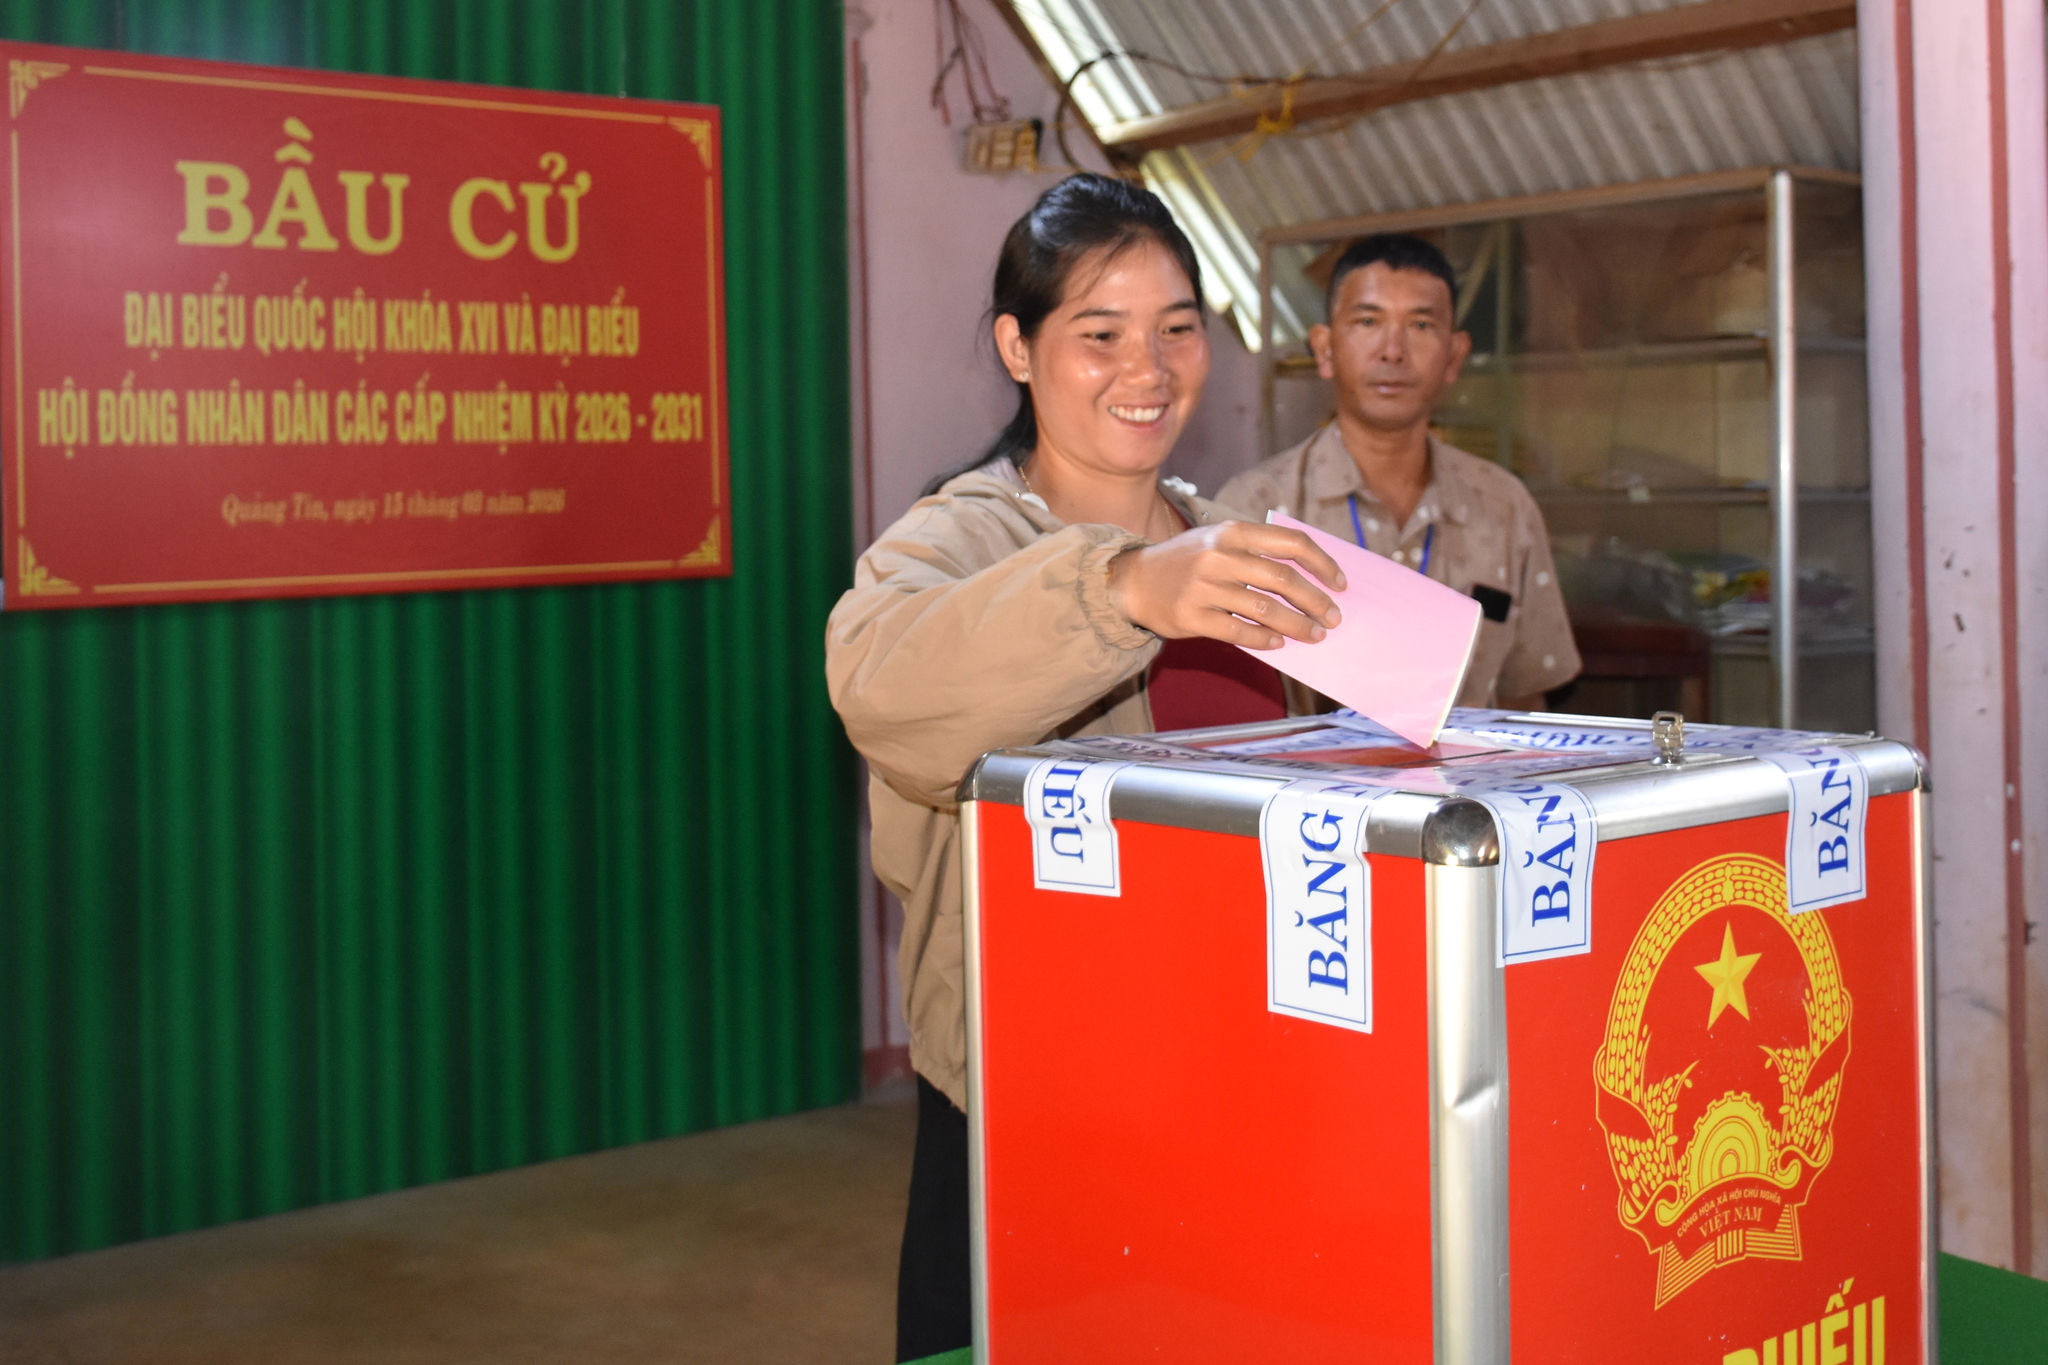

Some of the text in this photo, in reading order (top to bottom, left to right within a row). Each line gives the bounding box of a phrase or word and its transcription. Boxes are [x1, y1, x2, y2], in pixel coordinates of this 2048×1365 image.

[175, 117, 591, 262] BẦU CỬ
[125, 272, 640, 367] ĐẠI BIỂU QUỐC HỘI KHÓA XVI VÀ ĐẠI BIỂU
[39, 376, 89, 460] HỘI
[99, 370, 178, 446] ĐỒNG
[187, 378, 265, 445] NHÂN
[273, 378, 328, 445] DÂN
[336, 378, 388, 444] CÁC
[395, 371, 447, 444] CẤP
[453, 380, 532, 455] NHIỆM
[538, 381, 568, 442] KỲ
[575, 392, 631, 443] 2026
[652, 392, 703, 443] 2031
[1295, 809, 1348, 995] BĂNG
[1699, 1205, 1763, 1238] VIỆT NAM
[1722, 1277, 1886, 1365] IẾU
